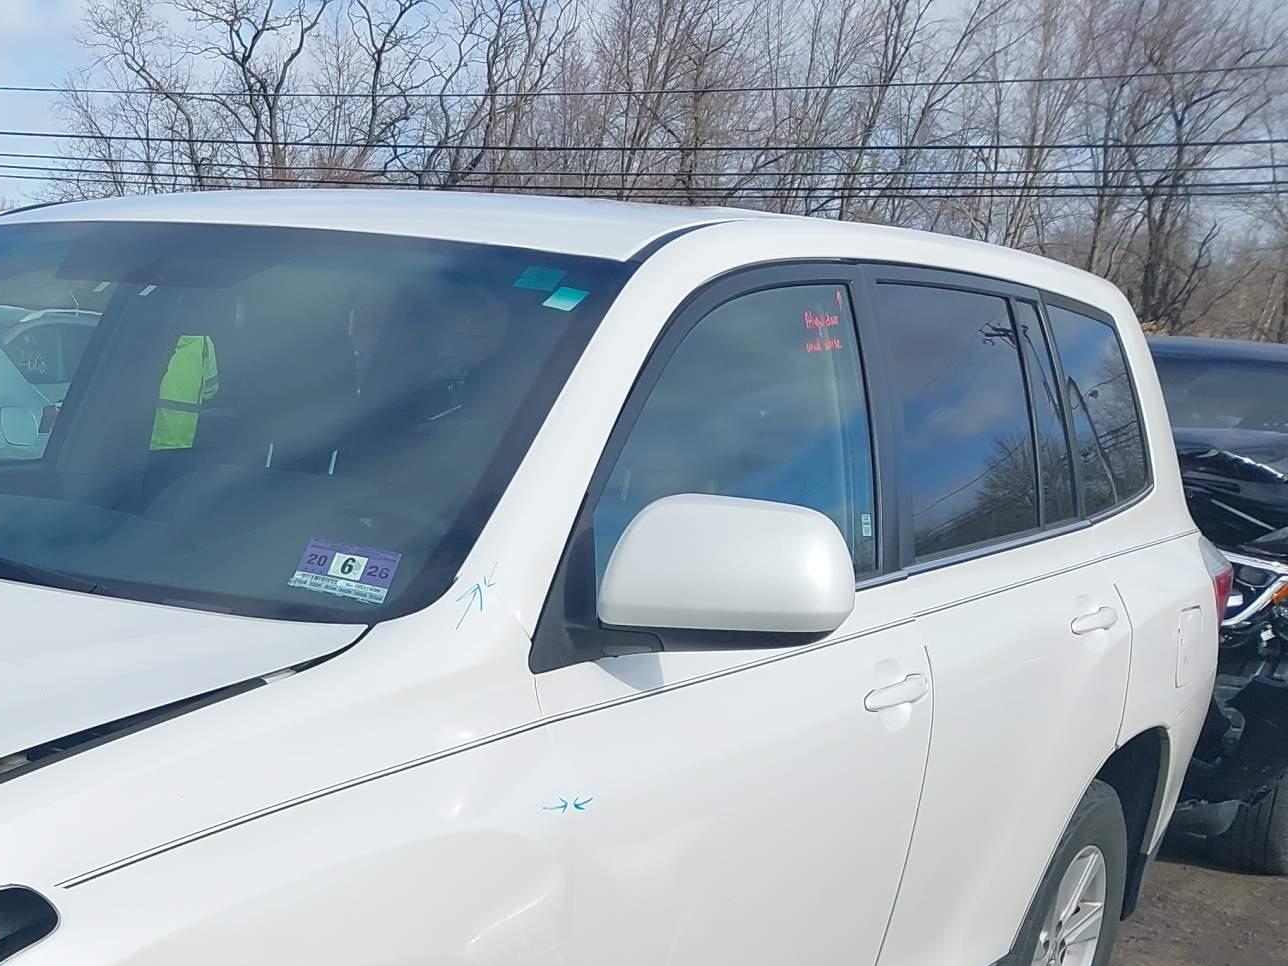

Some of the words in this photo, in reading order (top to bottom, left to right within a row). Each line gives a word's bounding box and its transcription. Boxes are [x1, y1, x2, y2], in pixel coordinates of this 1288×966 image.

[306, 553, 329, 567] 20
[340, 557, 356, 575] 6
[366, 565, 391, 579] 26
